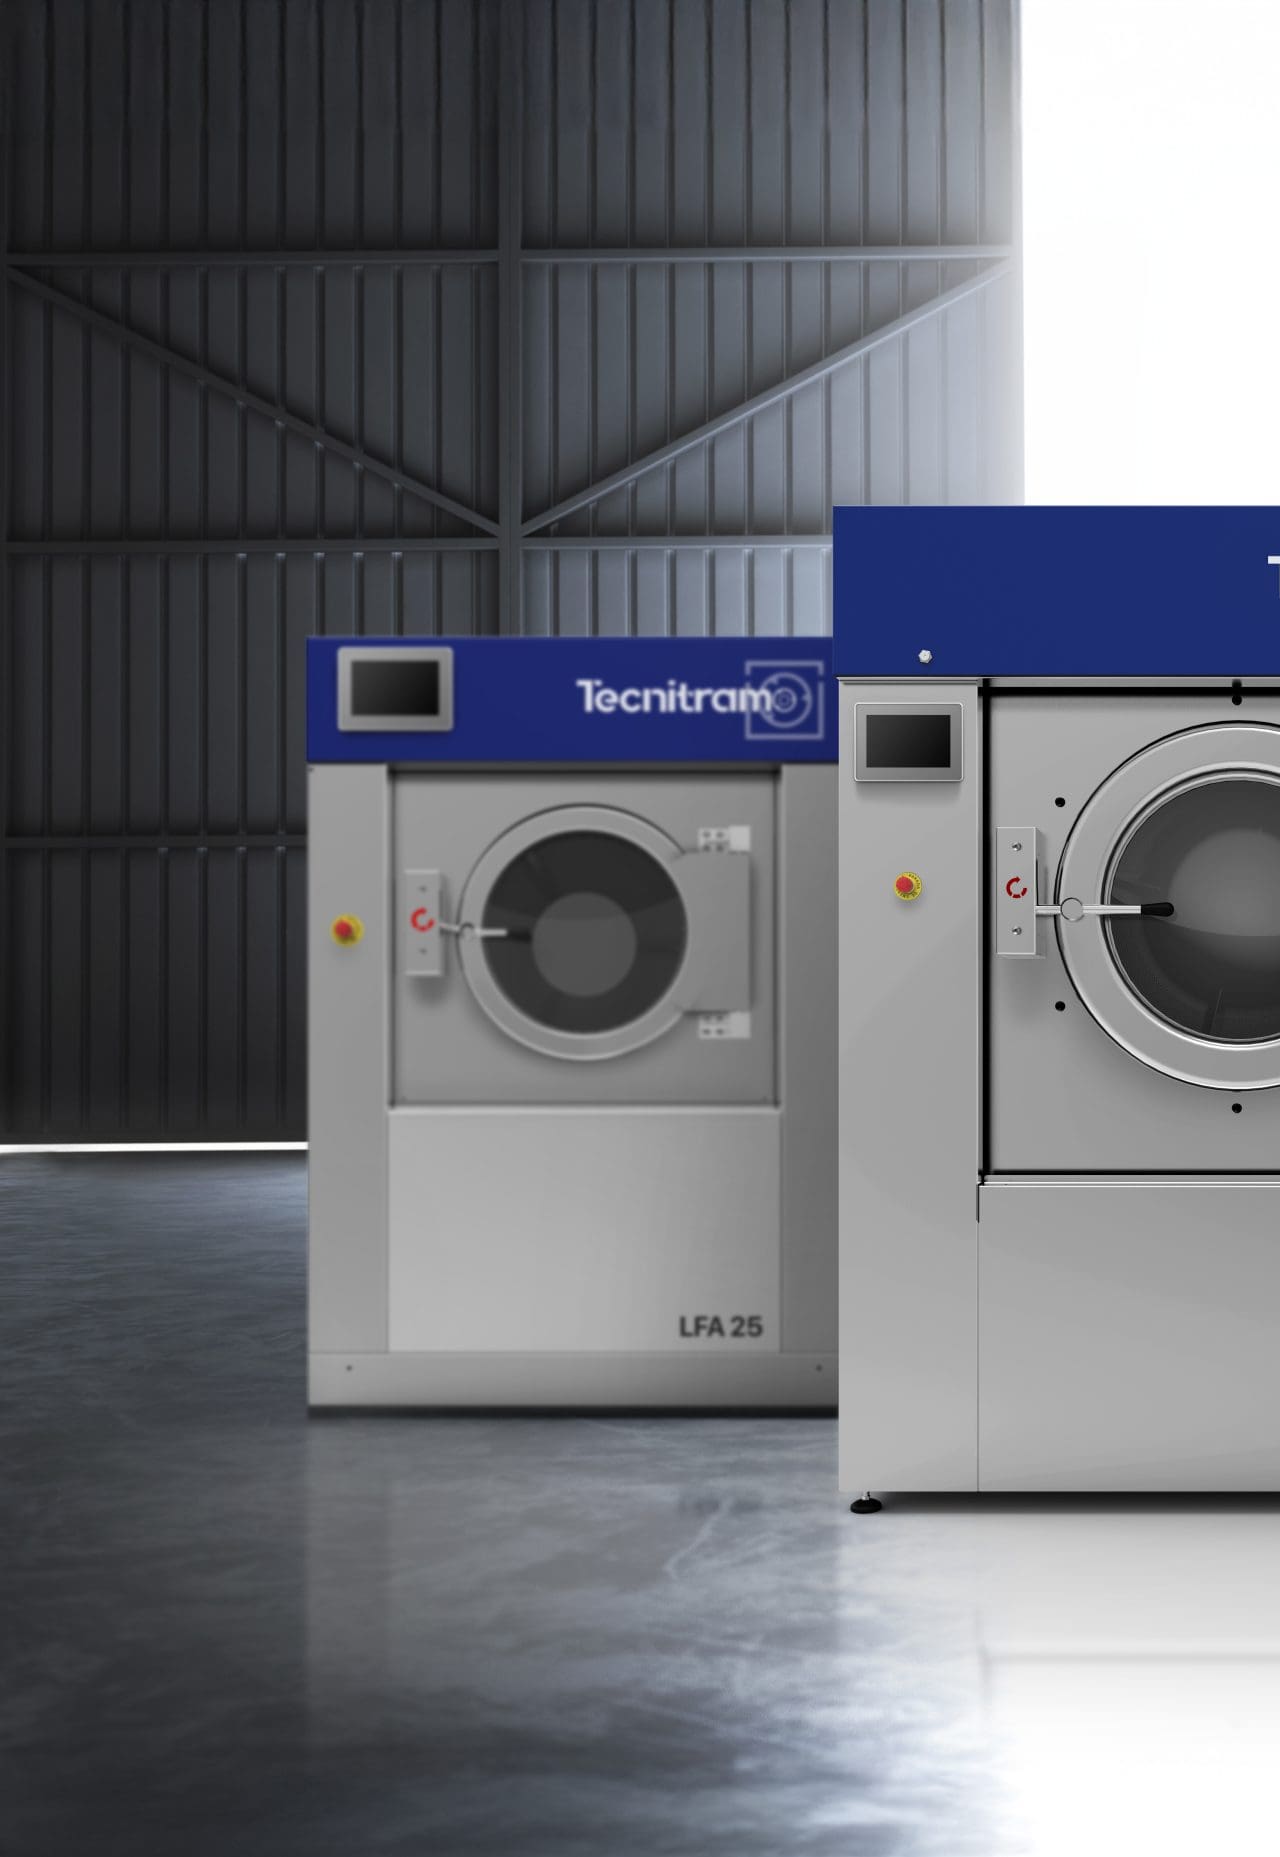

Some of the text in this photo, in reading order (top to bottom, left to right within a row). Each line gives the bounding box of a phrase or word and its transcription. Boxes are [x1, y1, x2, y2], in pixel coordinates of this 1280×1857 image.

[576, 678, 773, 714] Tecnitram
[679, 1314, 764, 1339] LFA 25
